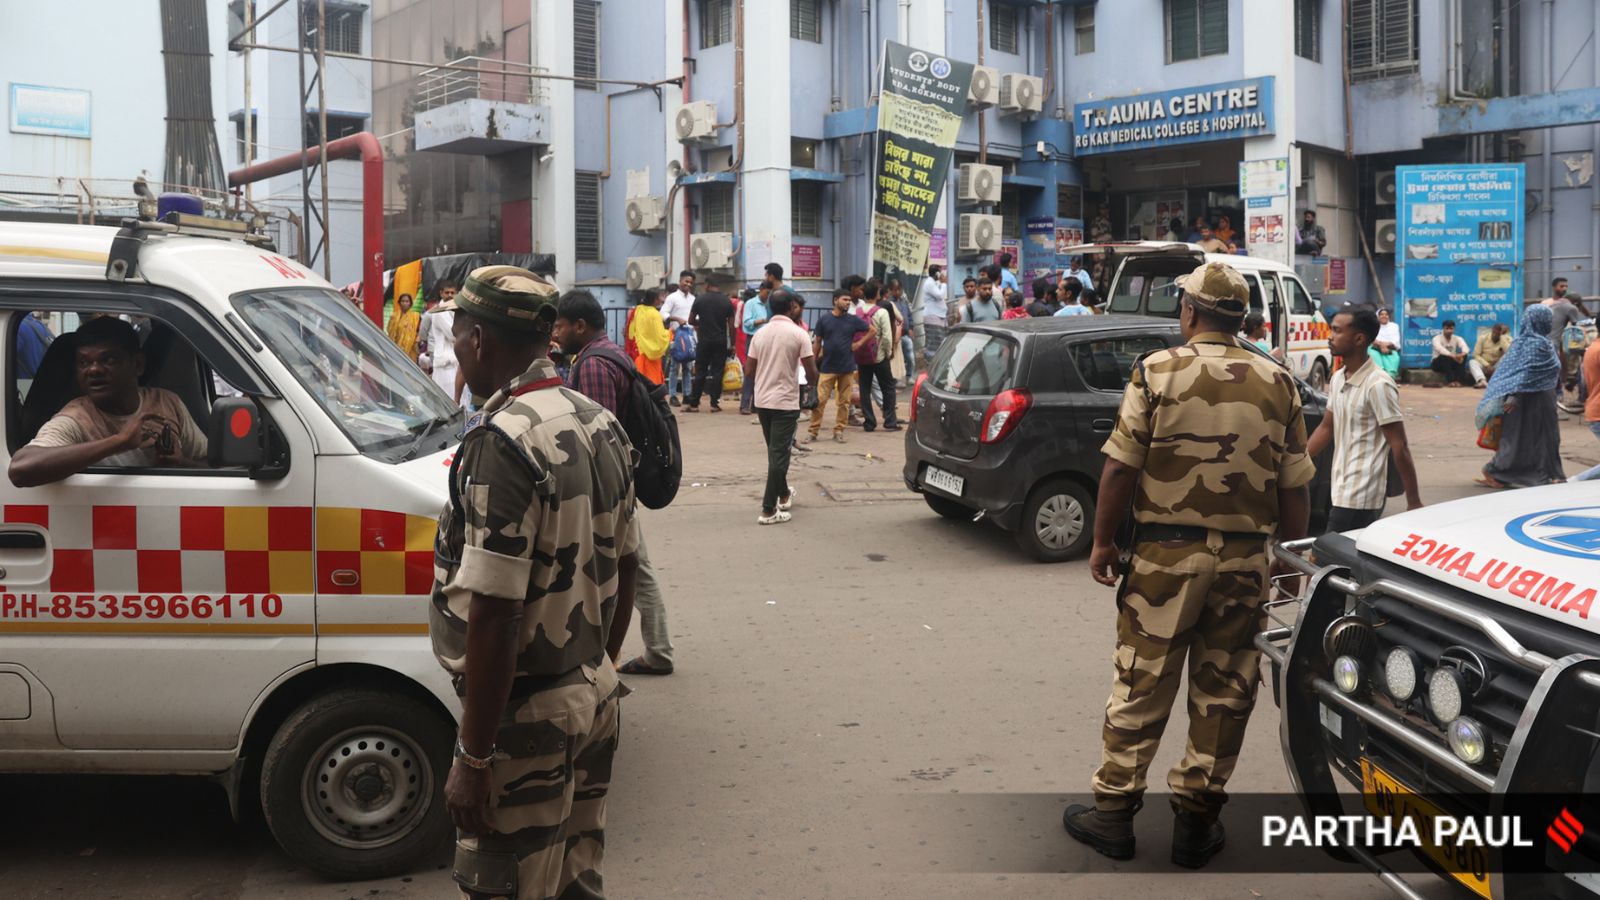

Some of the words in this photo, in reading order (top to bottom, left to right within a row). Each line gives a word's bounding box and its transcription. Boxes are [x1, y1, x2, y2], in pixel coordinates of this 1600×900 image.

[938, 81, 960, 93] BODY
[1082, 99, 1166, 128] TRAUMA
[1169, 86, 1258, 116] CENTRE
[1076, 134, 1088, 148] RG
[1090, 132, 1109, 146] KAR
[1111, 126, 1152, 144] MEDICAL
[1155, 120, 1200, 138] COLLEGE
[1202, 120, 1210, 132] &
[1212, 112, 1266, 131] HOSPITAL
[884, 140, 910, 162] বিচার
[2, 594, 283, 619] P.H-8535966110
